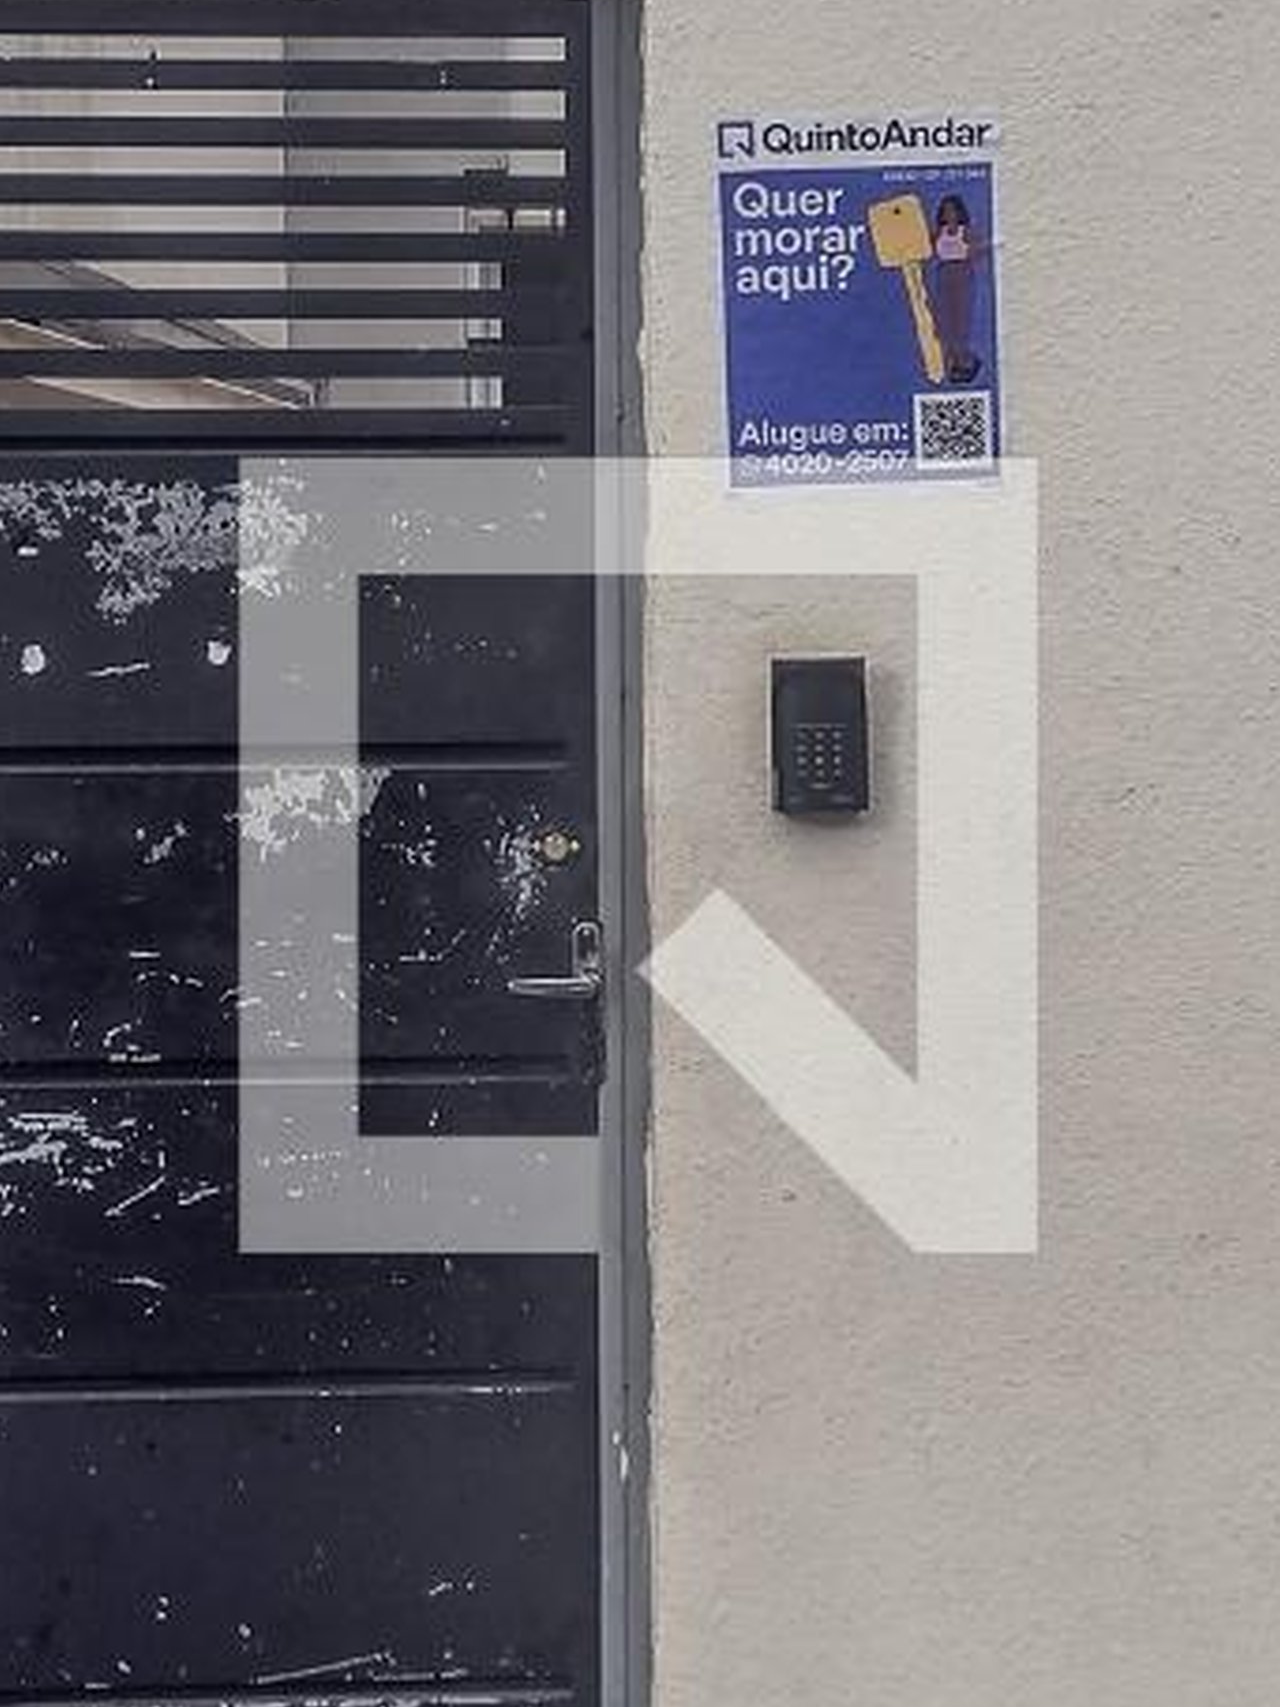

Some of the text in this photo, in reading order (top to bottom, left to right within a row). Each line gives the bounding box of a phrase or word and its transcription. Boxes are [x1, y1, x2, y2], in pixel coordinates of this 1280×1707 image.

[762, 119, 991, 154] QuintoAndar
[733, 182, 843, 219] Quer
[734, 225, 865, 256] morar
[736, 255, 854, 300] aqui?
[738, 419, 910, 452] Alugue em:
[765, 449, 910, 476] 4020-2507
